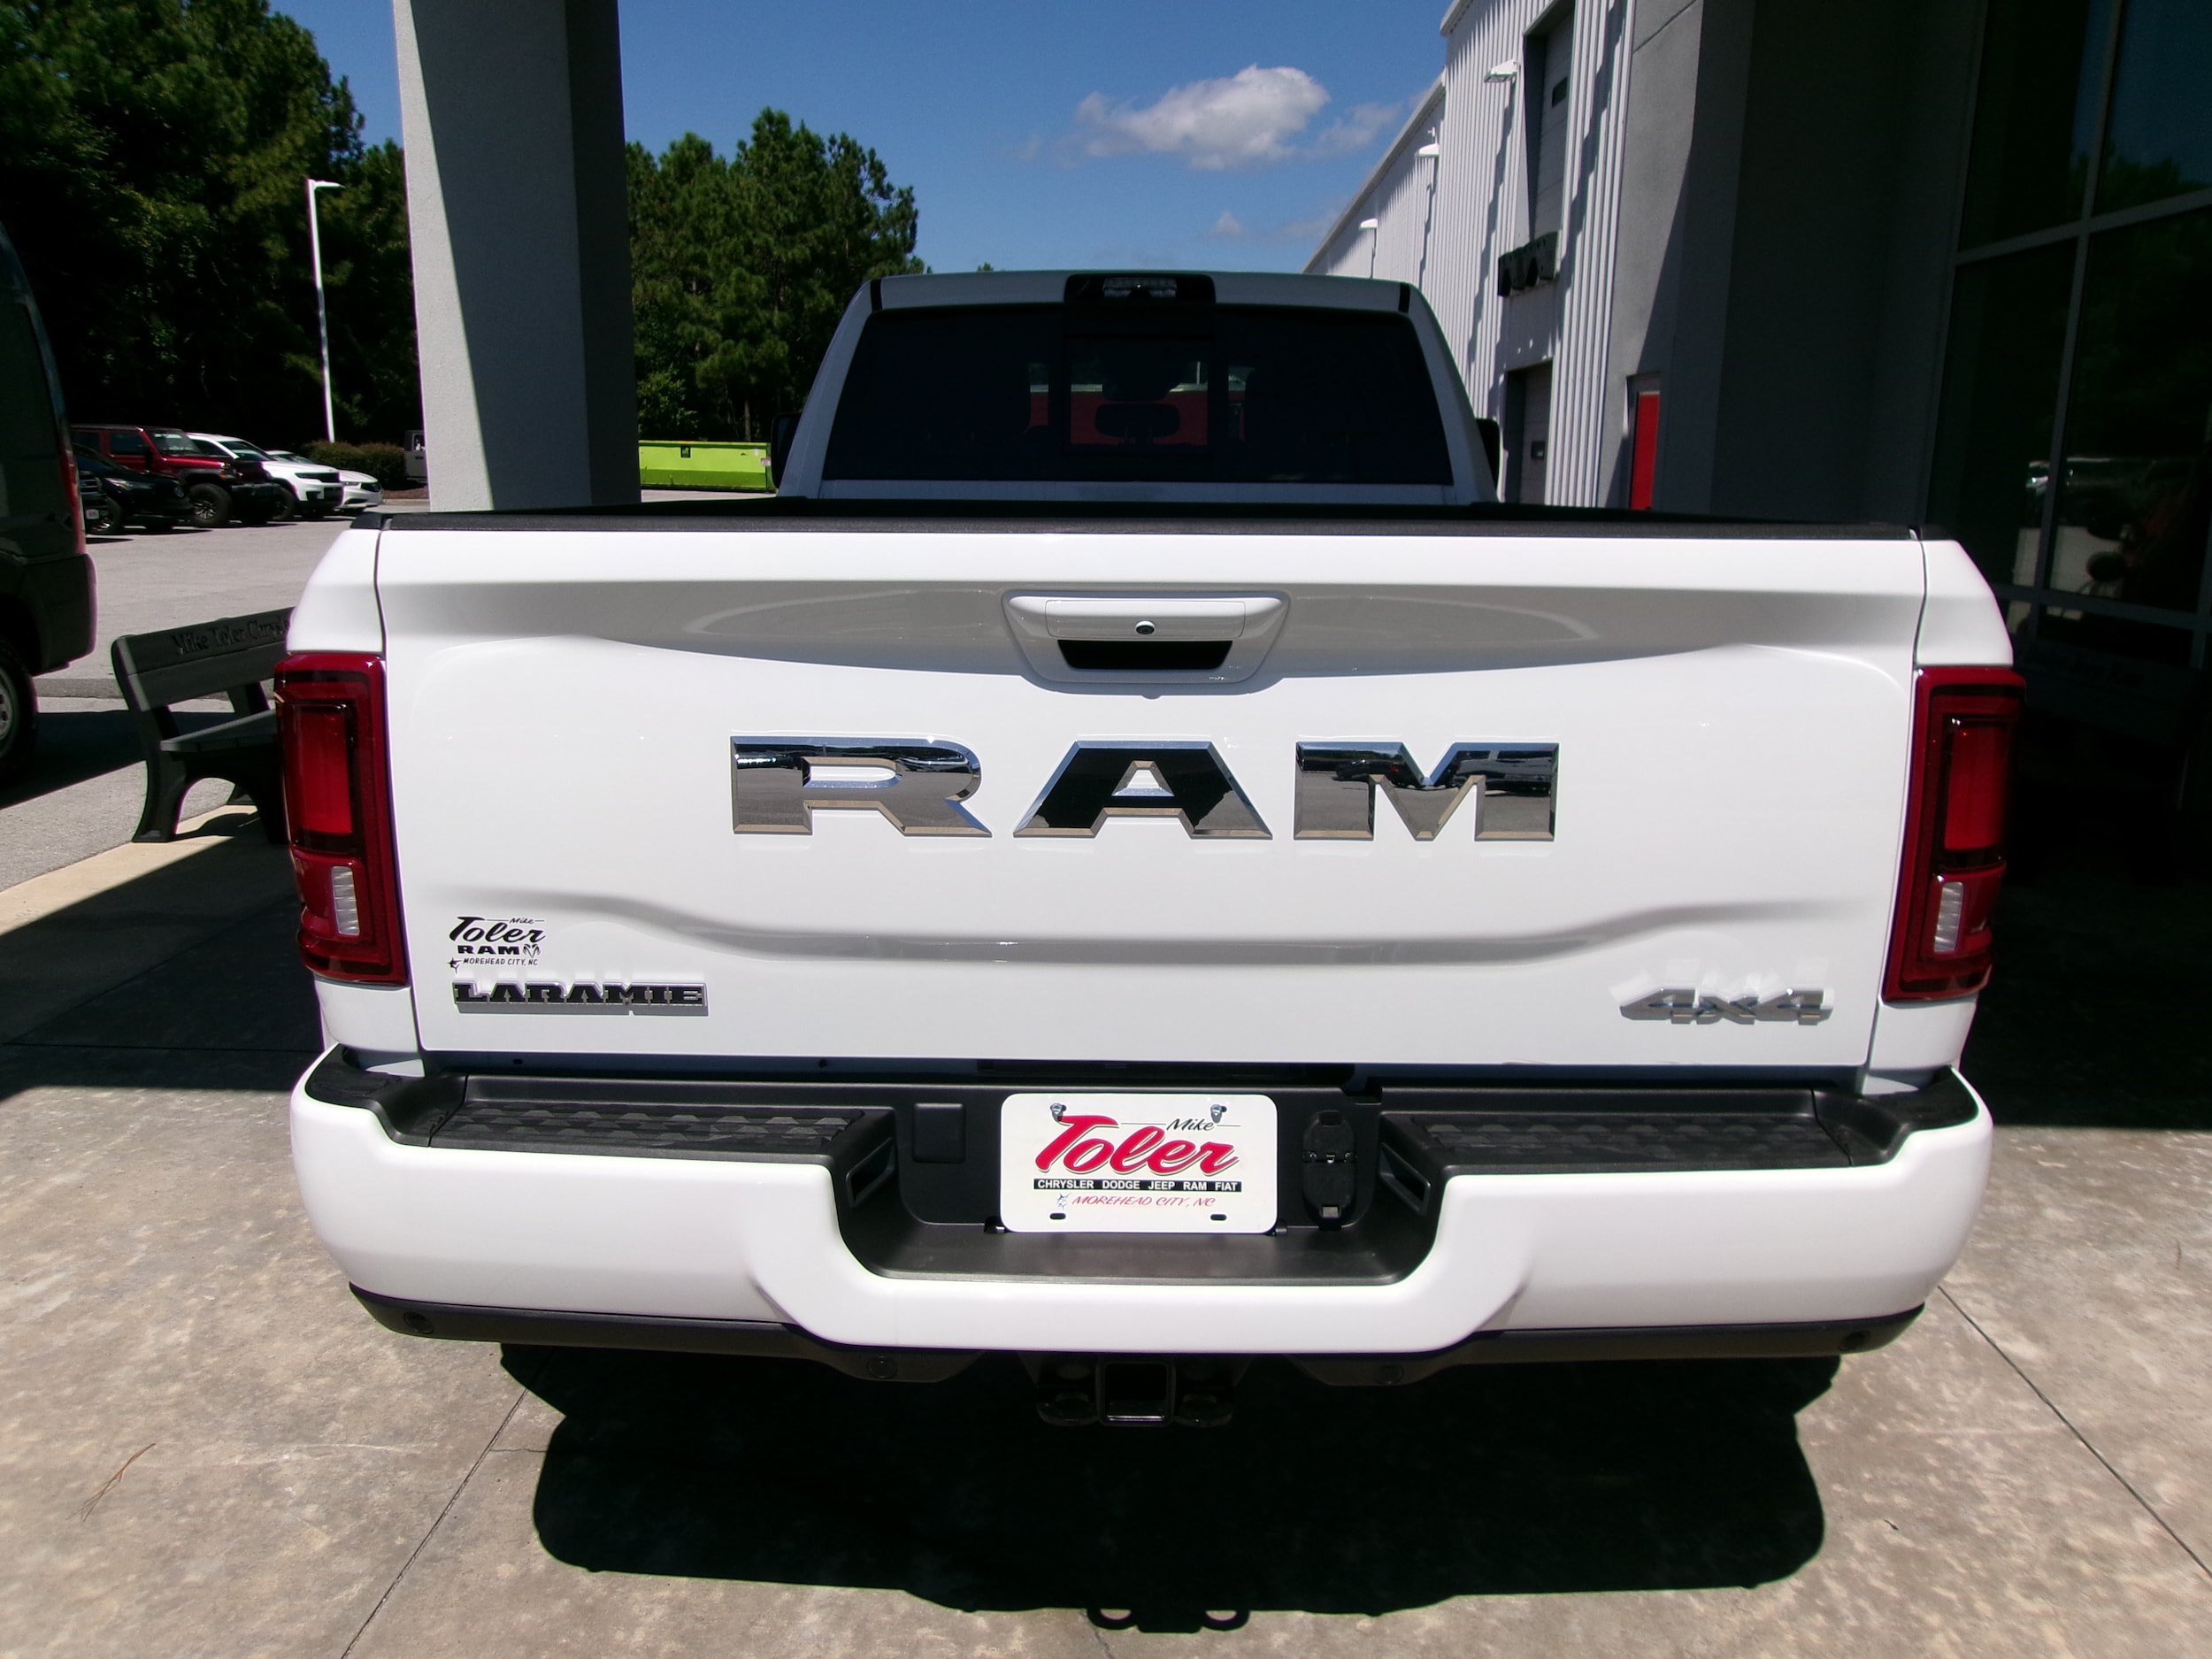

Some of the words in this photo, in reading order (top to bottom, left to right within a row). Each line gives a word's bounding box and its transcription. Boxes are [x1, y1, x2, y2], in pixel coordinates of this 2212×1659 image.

[170, 632, 209, 655] Mike
[208, 625, 245, 647] Toler
[729, 733, 1561, 842] RAM
[448, 916, 546, 943] Toler
[457, 945, 520, 956] RAM
[463, 956, 506, 965] MOREHEAD
[507, 957, 527, 966] CITY,
[452, 979, 709, 1017] LARAMIE
[1166, 1118, 1216, 1132] Mike
[1035, 1115, 1240, 1177] Toler
[1037, 1179, 1094, 1189] CHRYSLER
[1102, 1179, 1141, 1190] DODGE
[1148, 1180, 1176, 1191] JEEP
[1183, 1181, 1208, 1191] RAM
[1215, 1181, 1238, 1192] FIAT
[1071, 1195, 1153, 1207] MOREHEAD
[1154, 1196, 1191, 1208] CITY,
[1194, 1197, 1216, 1208] NC
